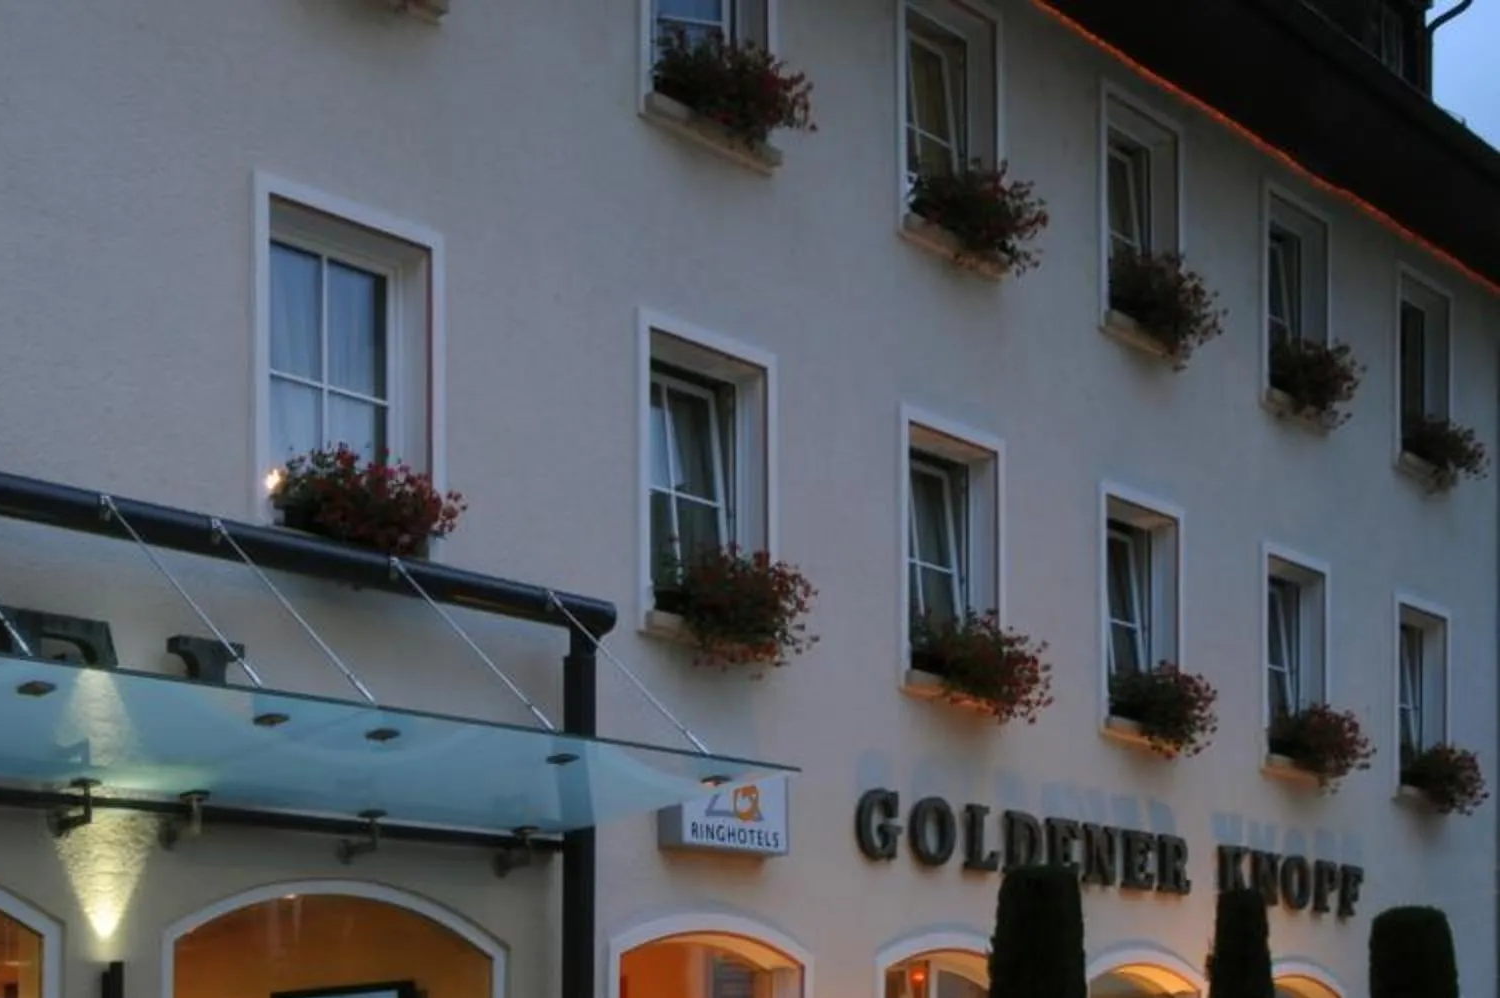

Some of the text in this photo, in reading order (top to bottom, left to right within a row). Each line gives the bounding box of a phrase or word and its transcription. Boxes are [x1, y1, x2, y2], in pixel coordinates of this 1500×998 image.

[691, 821, 779, 849] RINGHOTELS
[856, 788, 1364, 917] GOLDENER KNOPF
